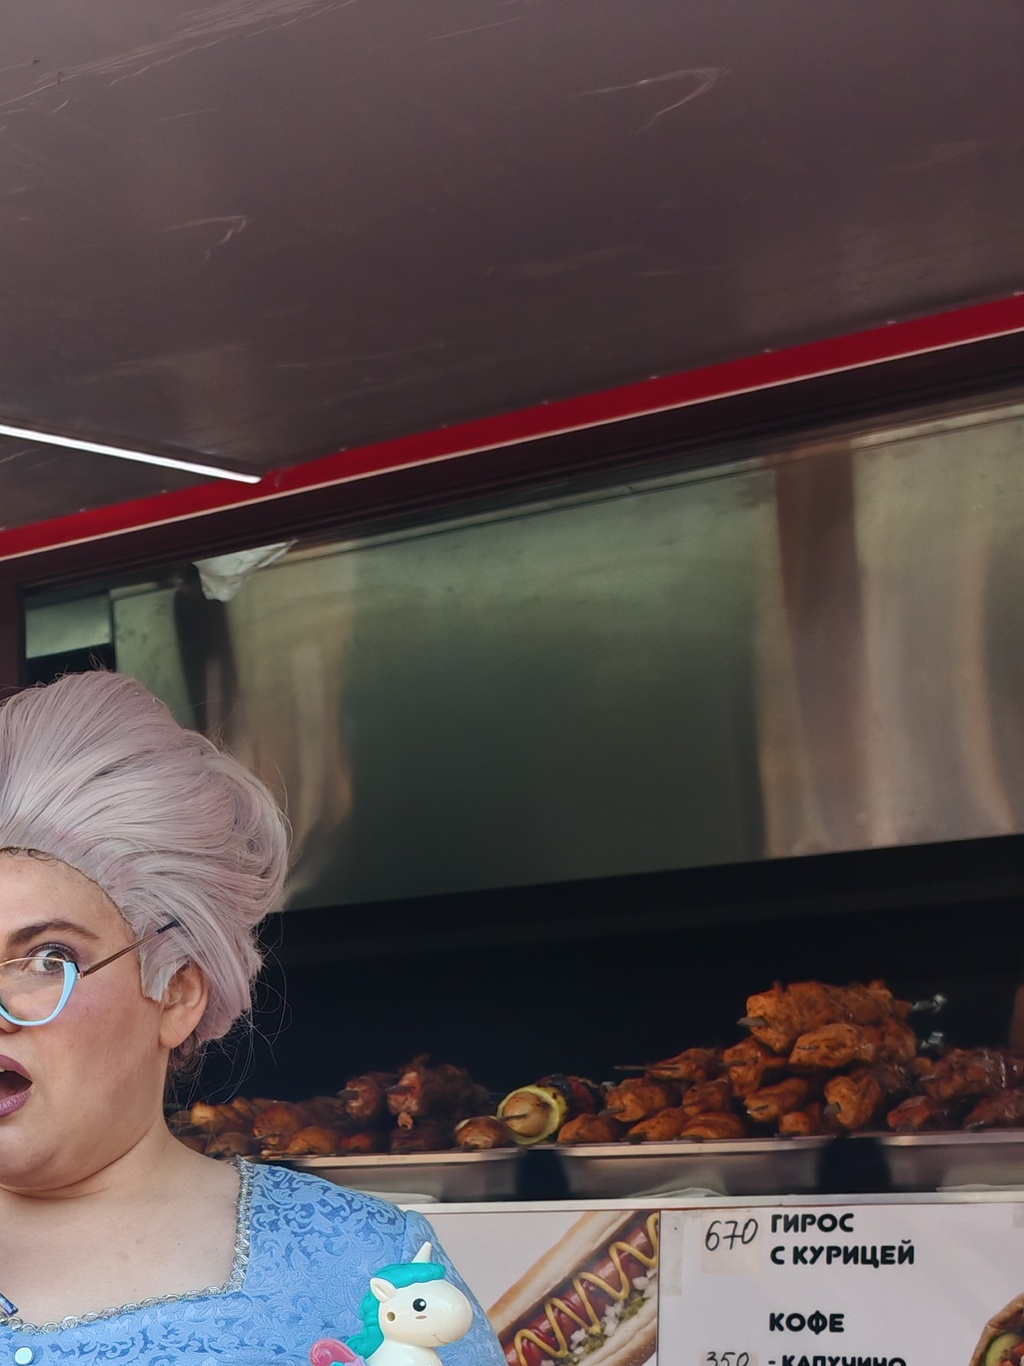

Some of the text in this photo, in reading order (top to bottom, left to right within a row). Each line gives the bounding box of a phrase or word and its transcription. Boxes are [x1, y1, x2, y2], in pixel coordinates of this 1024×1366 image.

[705, 1218, 759, 1251] 670
[771, 1213, 854, 1233] ГИРОС
[770, 1239, 915, 1268] С КУРИЦЕЙ
[769, 1310, 845, 1335] КОФЕ
